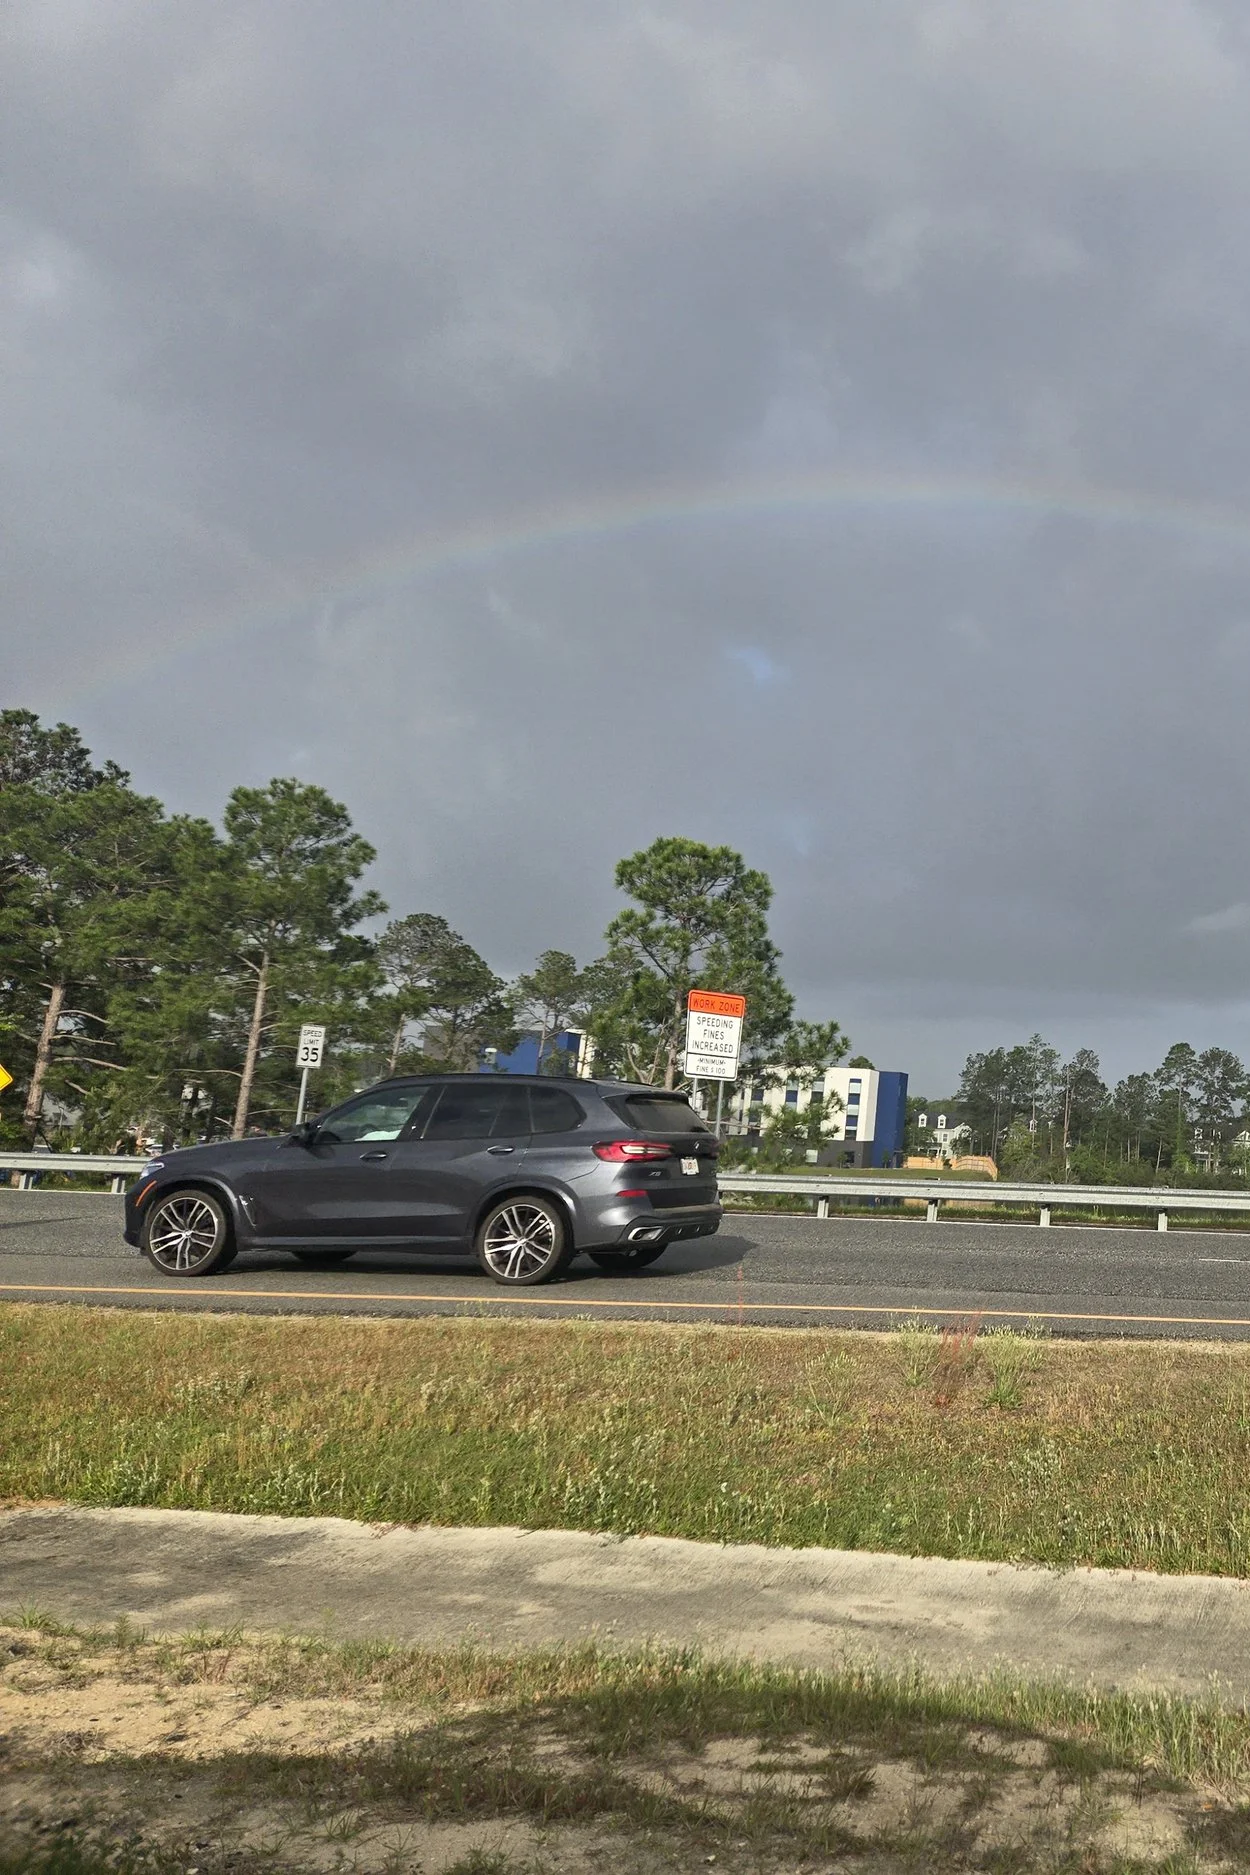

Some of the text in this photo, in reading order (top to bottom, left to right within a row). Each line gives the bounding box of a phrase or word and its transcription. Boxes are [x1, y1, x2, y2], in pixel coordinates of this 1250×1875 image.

[693, 998, 741, 1013] WORK ZONE
[696, 1016, 734, 1029] SPEEDING
[303, 1029, 322, 1038] SPEED
[703, 1029, 725, 1040] FINES
[692, 1039, 734, 1054] INCREASED
[300, 1046, 319, 1062] 35
[695, 1065, 709, 1073] FINE
